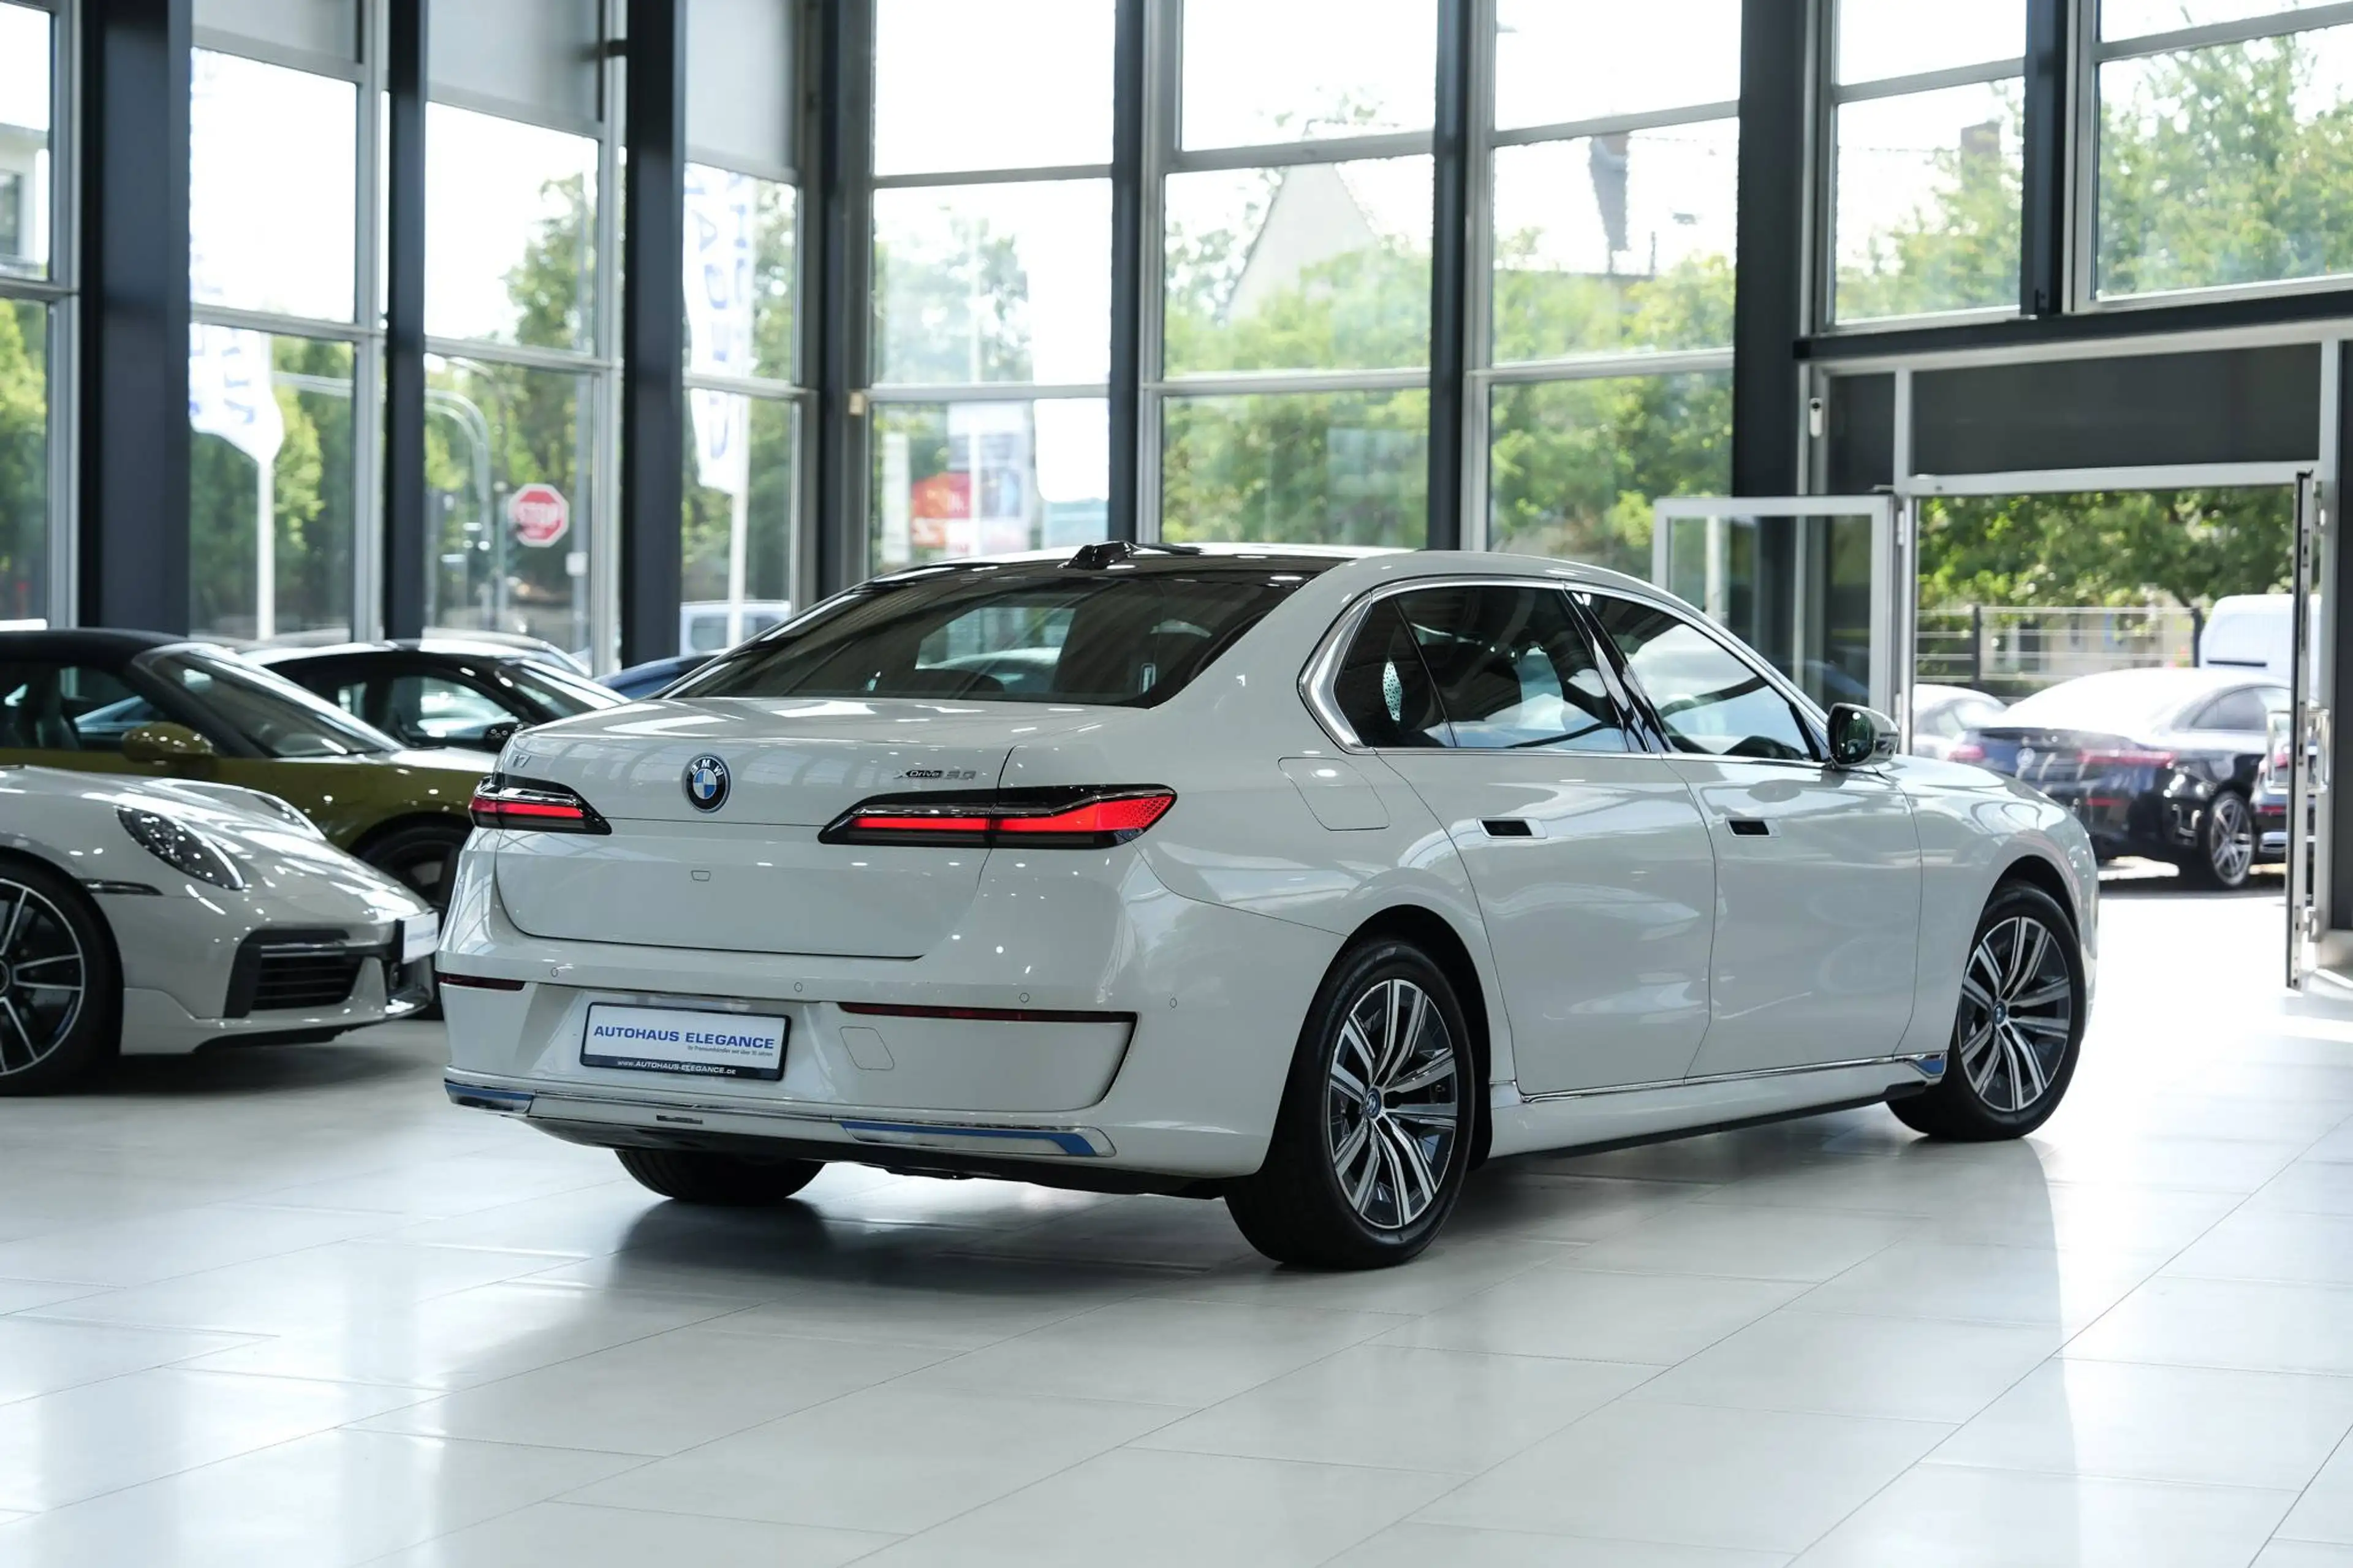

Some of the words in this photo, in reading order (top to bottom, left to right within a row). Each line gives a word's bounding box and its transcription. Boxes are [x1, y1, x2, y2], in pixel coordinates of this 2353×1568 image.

[689, 759, 724, 777] BMW
[594, 1026, 680, 1042] AUTOHAUS
[685, 1032, 775, 1049] ELEGANCE
